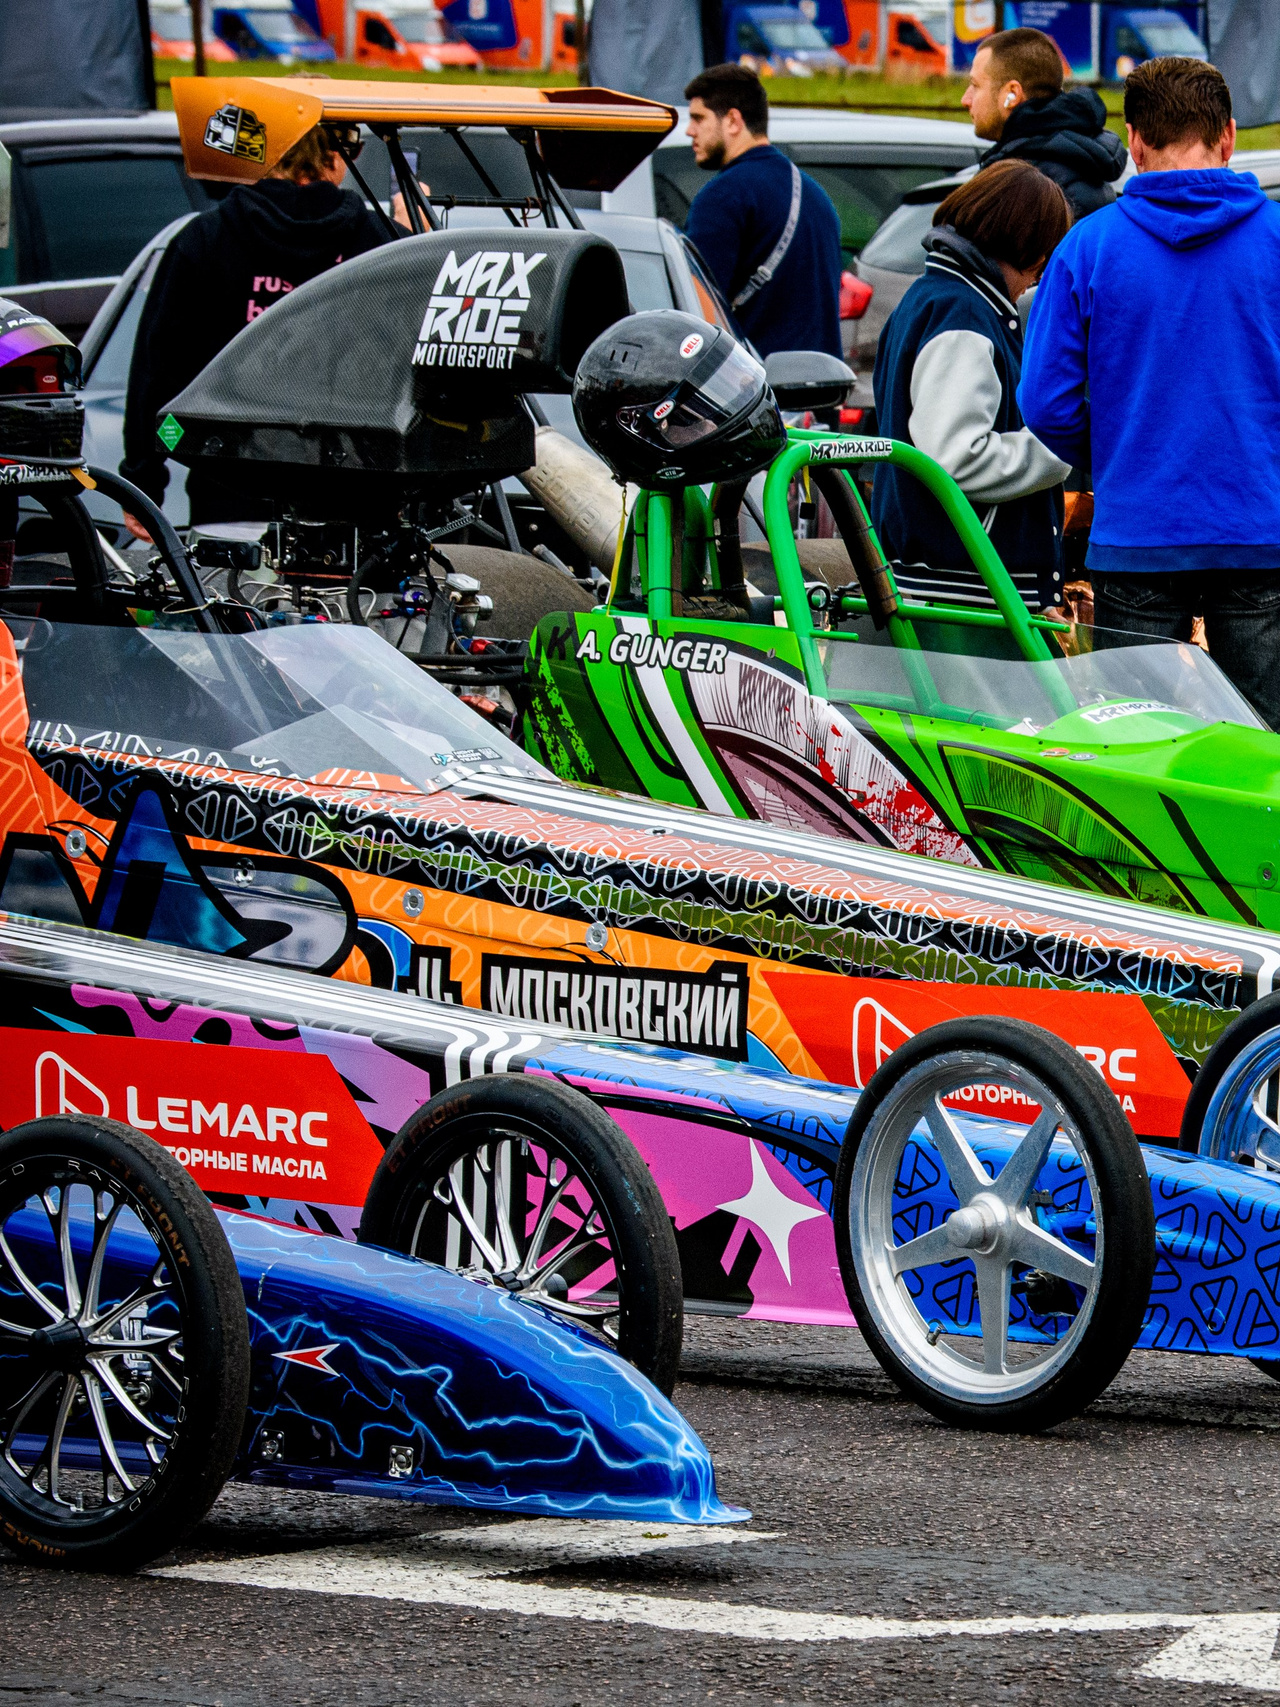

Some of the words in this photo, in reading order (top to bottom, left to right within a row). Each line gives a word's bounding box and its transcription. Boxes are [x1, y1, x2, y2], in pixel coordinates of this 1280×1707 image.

[432, 250, 547, 298] MAX
[411, 342, 517, 370] MOTORSPORT
[682, 336, 700, 355] BELL
[655, 403, 671, 418] BELL
[576, 630, 601, 661] A.
[609, 633, 728, 673] GUNGER
[490, 965, 741, 1048] МОСКОВСКИЙ
[126, 1085, 328, 1148] LEMARC
[164, 1146, 248, 1172] ТОРНЫЕ
[252, 1154, 328, 1181] МАСЛА
